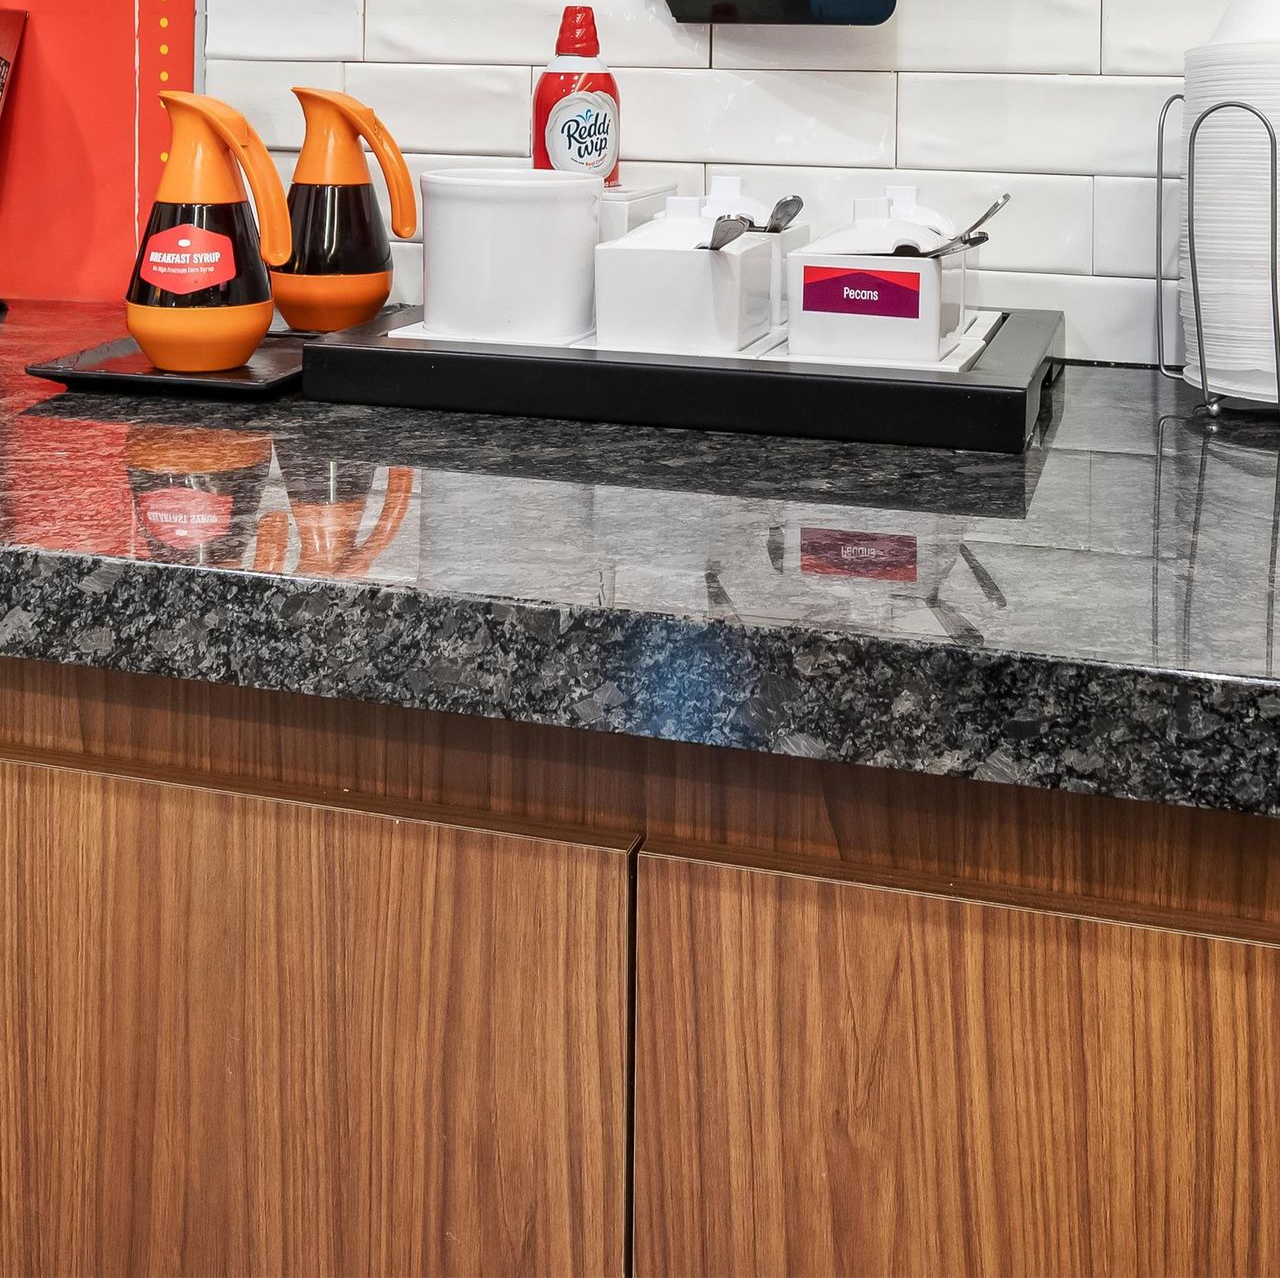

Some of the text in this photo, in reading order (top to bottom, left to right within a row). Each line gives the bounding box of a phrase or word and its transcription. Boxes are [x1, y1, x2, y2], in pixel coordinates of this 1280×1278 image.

[561, 112, 611, 150] Reddi
[149, 251, 221, 264] BREAKFAST SYRUP
[844, 287, 878, 301] Pecans
